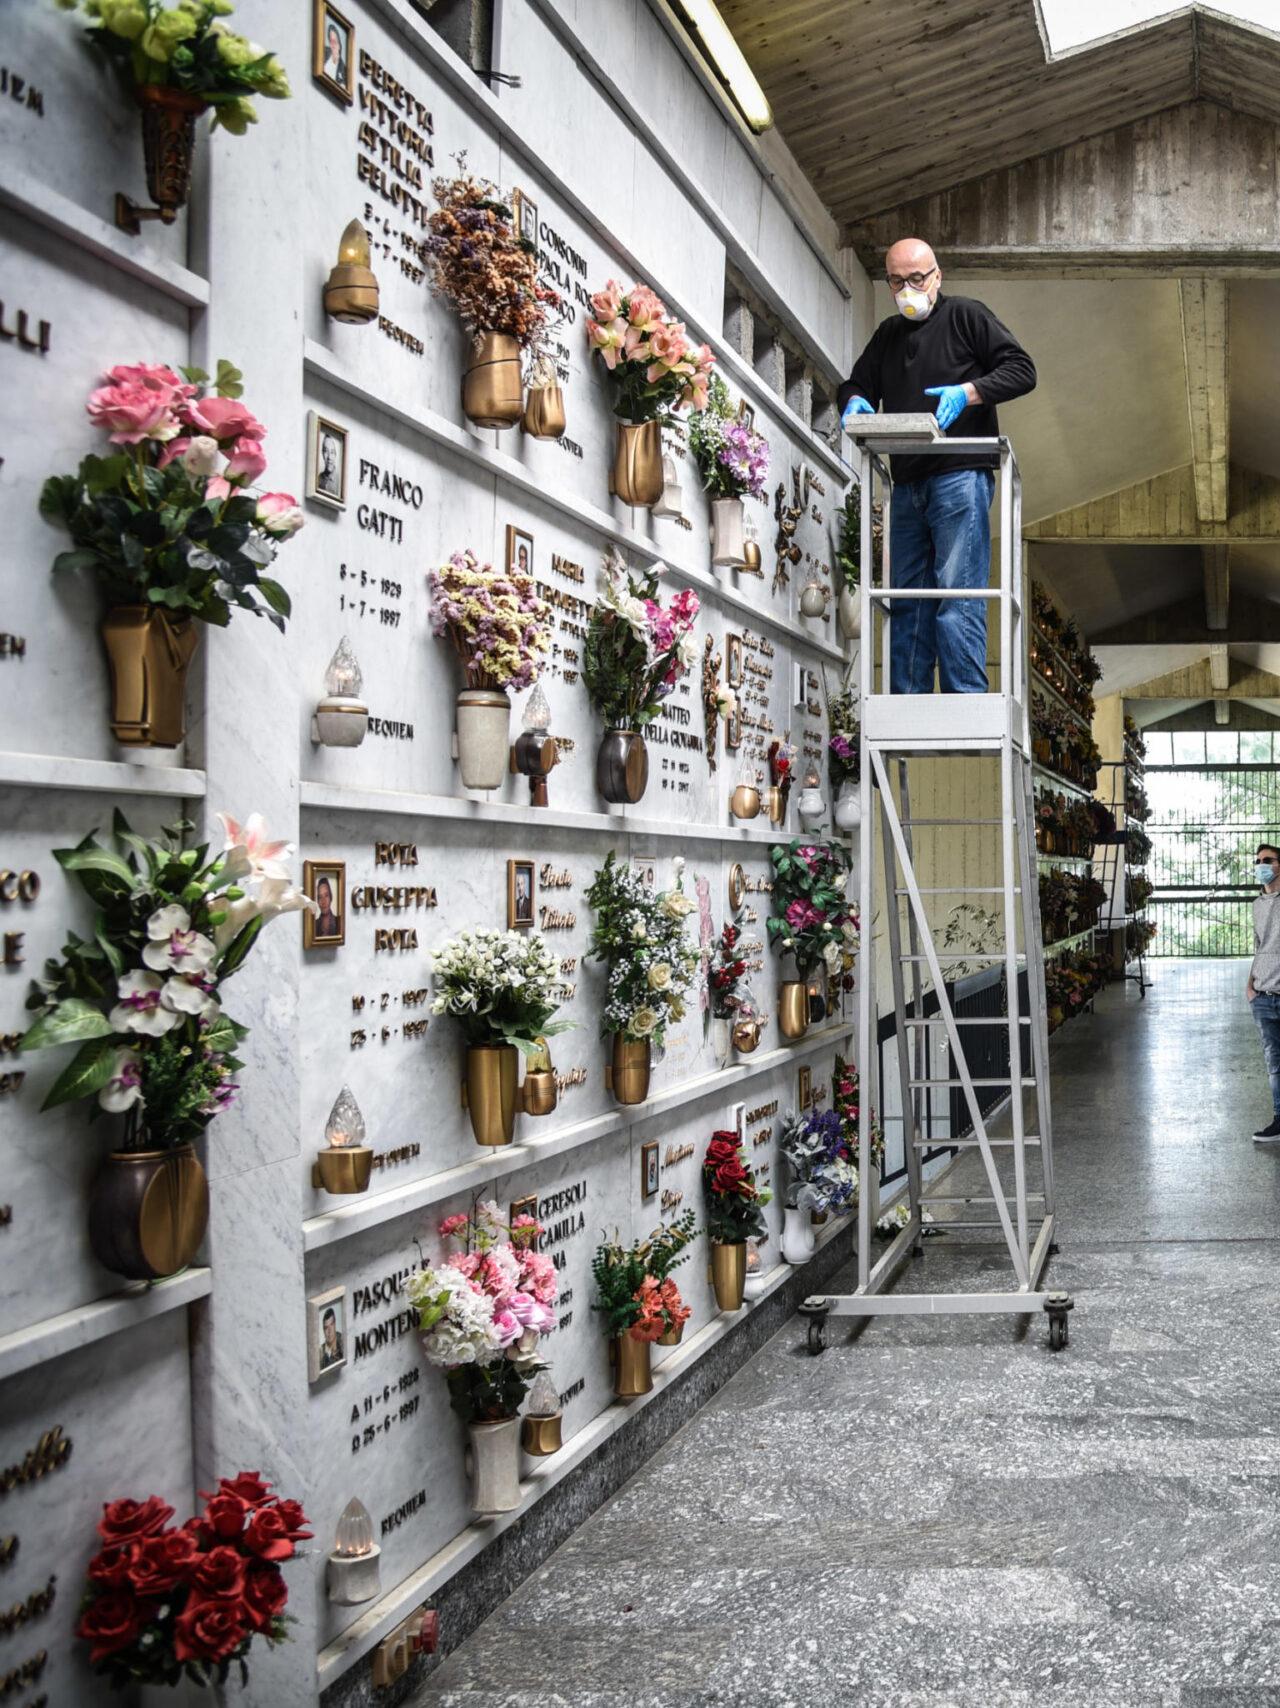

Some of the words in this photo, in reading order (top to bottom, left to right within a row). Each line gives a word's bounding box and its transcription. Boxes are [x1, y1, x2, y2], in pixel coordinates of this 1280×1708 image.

[359, 48, 434, 136] BERETTA
[358, 82, 434, 168] VITTORIA
[359, 457, 424, 511] FRANCO
[357, 503, 404, 545] GATTI
[367, 716, 414, 740] REQUIEM
[375, 842, 419, 867] ROTA
[351, 885, 438, 910] GIUSEPPA
[375, 927, 419, 952] ROTA
[354, 1306, 421, 1362] MONTEN
